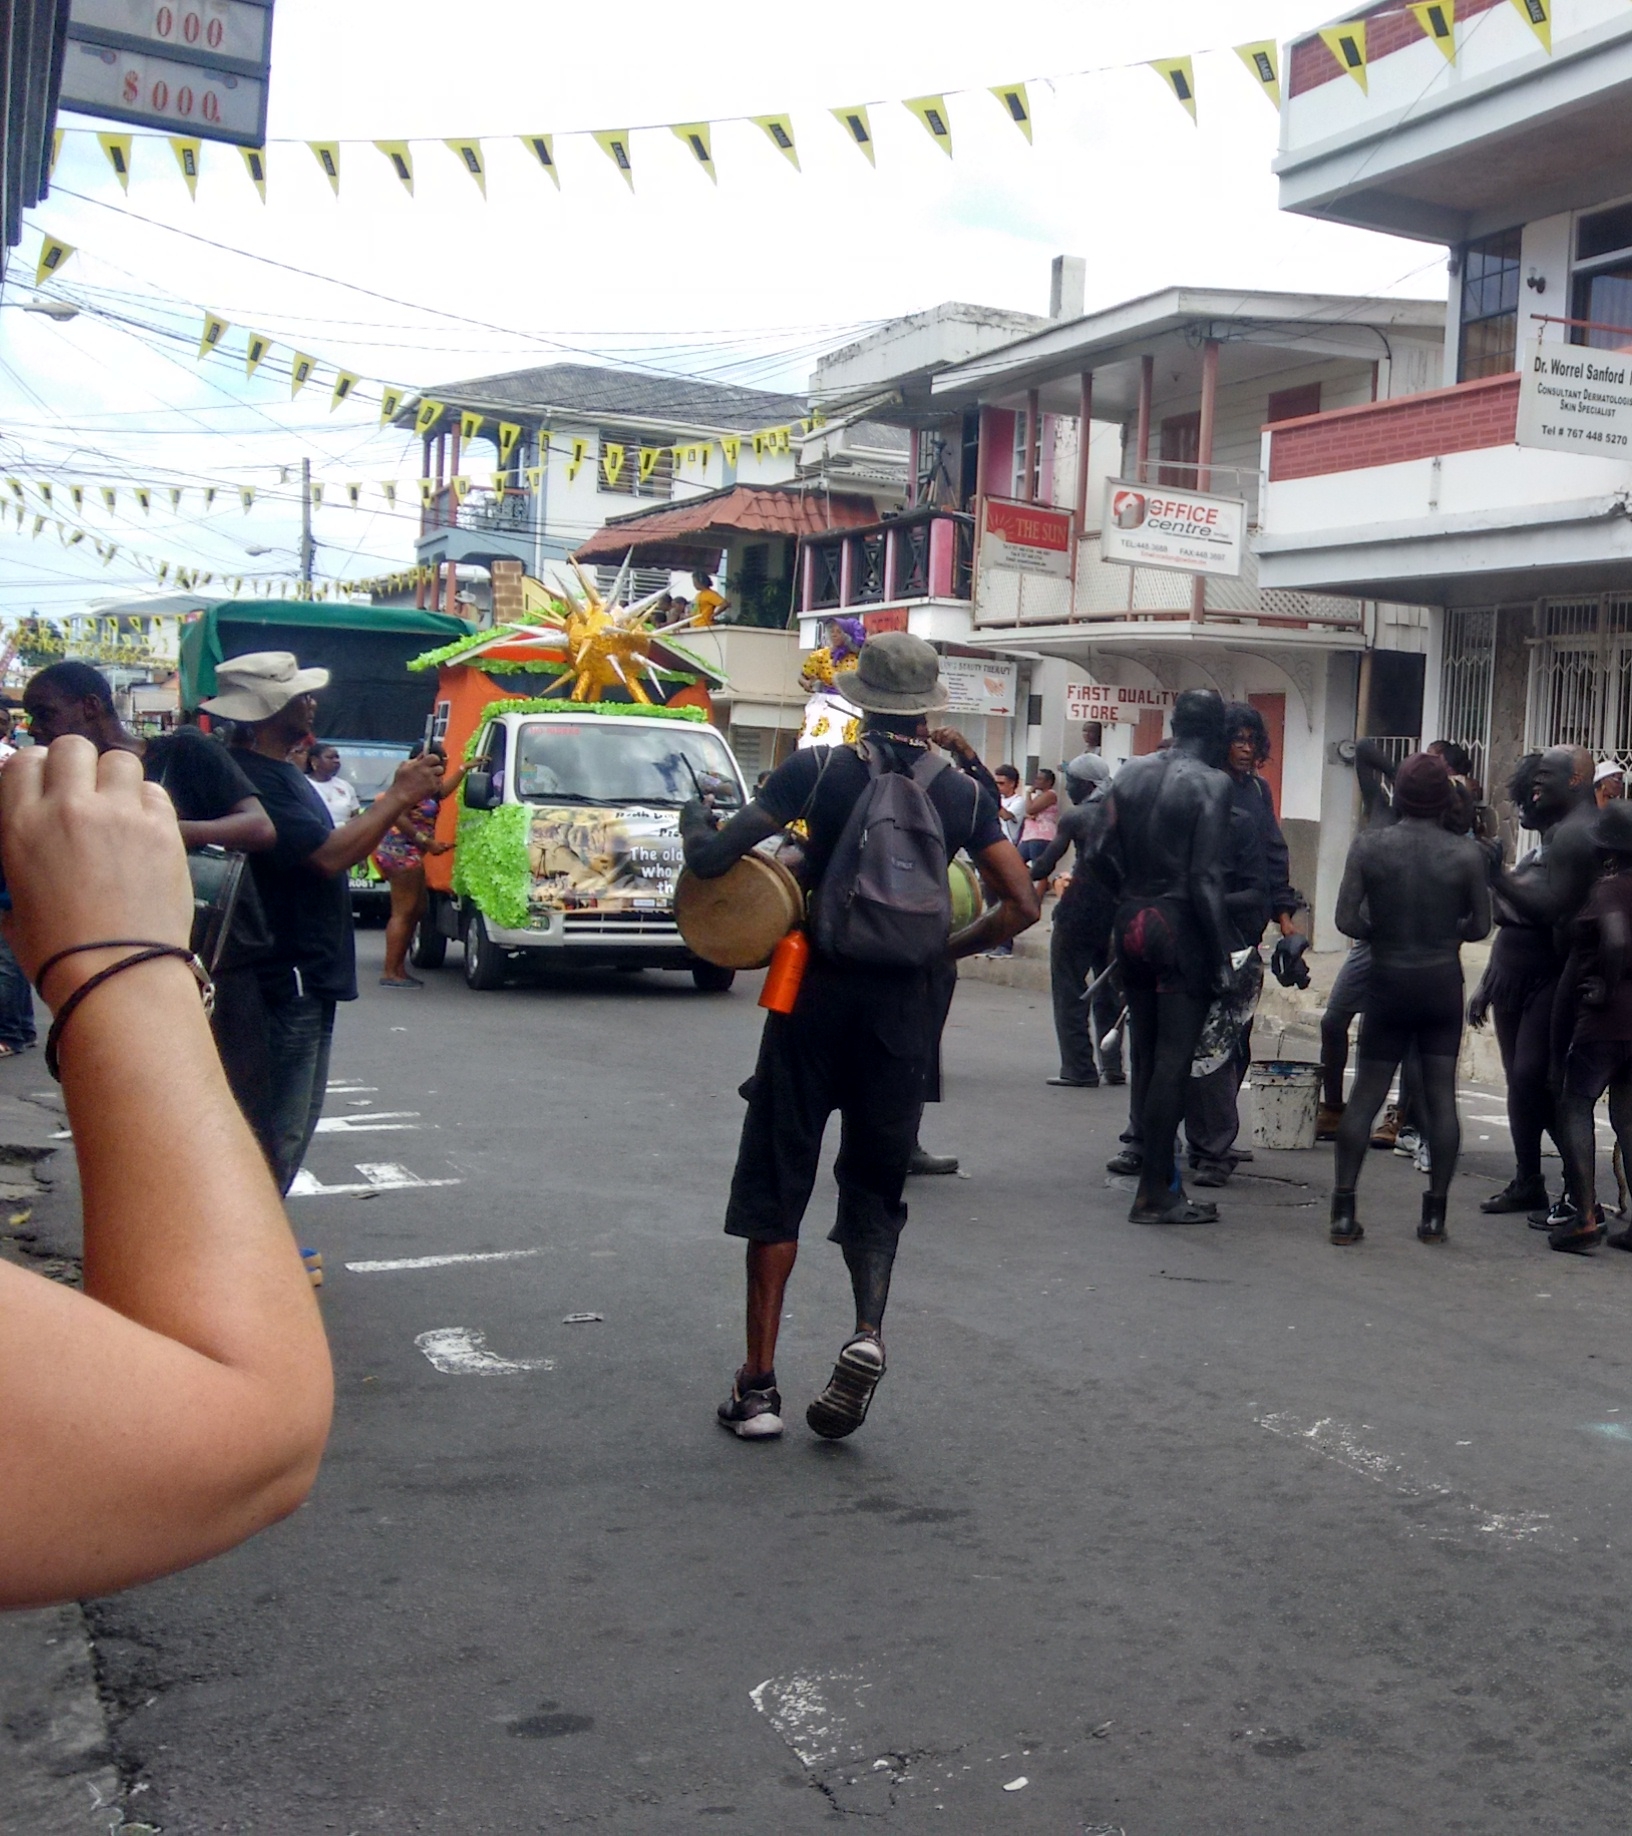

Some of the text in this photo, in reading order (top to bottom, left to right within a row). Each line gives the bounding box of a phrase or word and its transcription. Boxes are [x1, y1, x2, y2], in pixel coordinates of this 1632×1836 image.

[1534, 356, 1548, 373] Dr.
[1550, 358, 1584, 379] Worrel
[1586, 364, 1625, 384] Sanford
[1541, 425, 1556, 436] Tel
[1567, 428, 1584, 439] 767
[1586, 431, 1603, 442] 448
[1605, 434, 1628, 445] 5270
[1150, 499, 1219, 525] OFFICE
[1016, 517, 1067, 544] THE SUN
[1147, 518, 1212, 537] centre
[1071, 703, 1119, 720] STORE
[630, 846, 684, 861] The old
[641, 863, 672, 878] who
